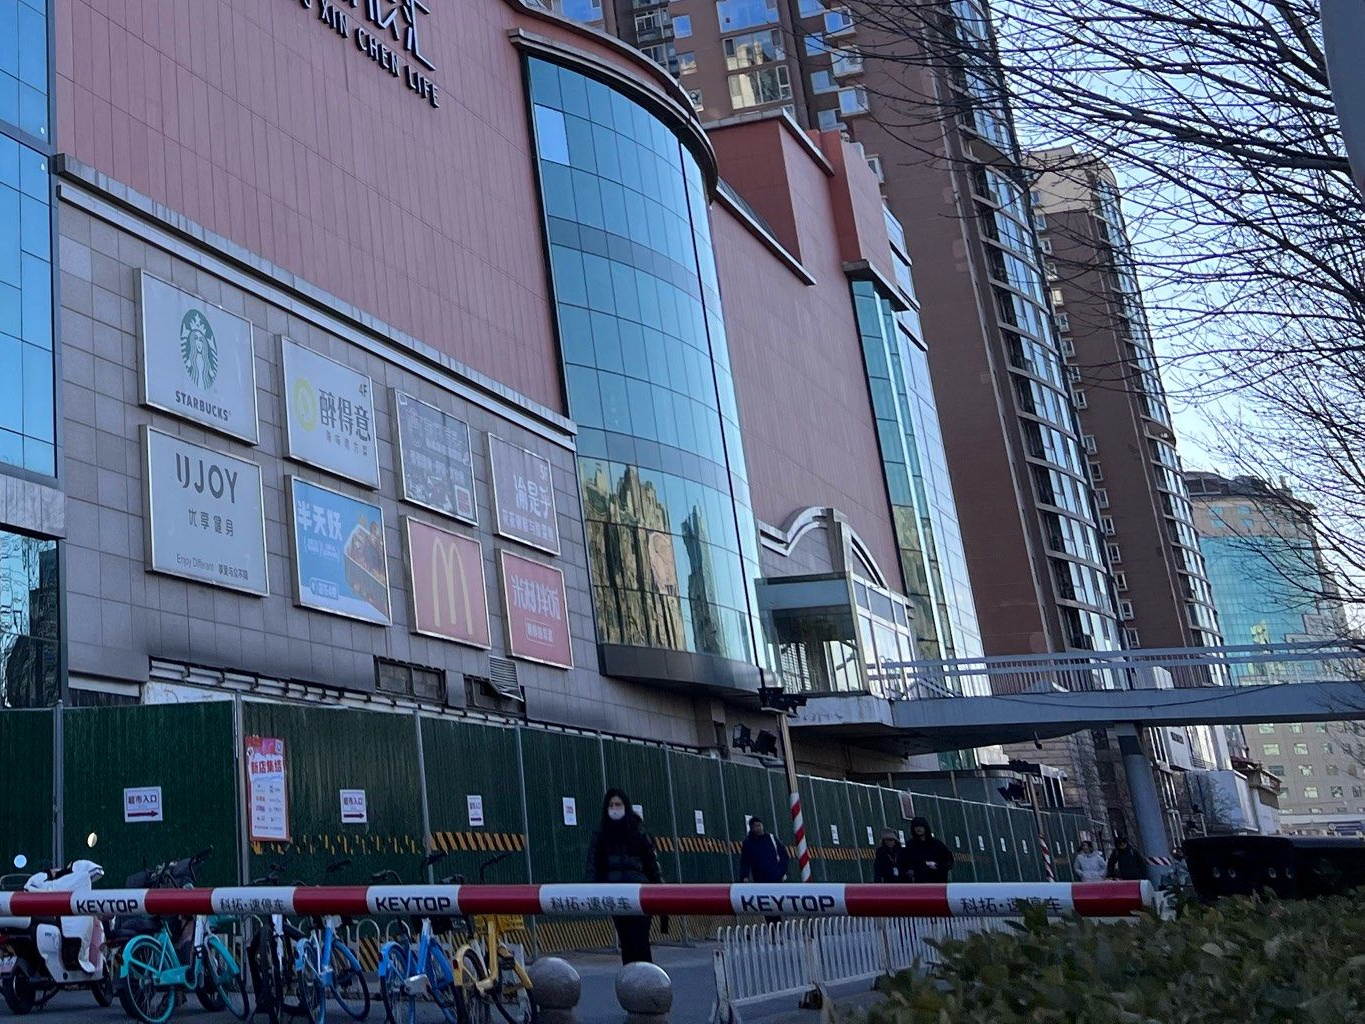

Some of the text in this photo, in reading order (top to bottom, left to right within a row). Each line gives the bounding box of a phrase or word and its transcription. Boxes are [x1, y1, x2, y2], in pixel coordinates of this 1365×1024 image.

[355, 27, 400, 77] CHEN
[404, 65, 439, 109] LIFE
[358, 383, 367, 397] 4F
[175, 390, 229, 422] STARBUCKS
[319, 388, 371, 442] 醉得意
[188, 508, 234, 537] 优享健身
[76, 899, 139, 914] KEYTOP
[375, 896, 451, 912] KEYTOP
[740, 895, 835, 912] KEYTOP
